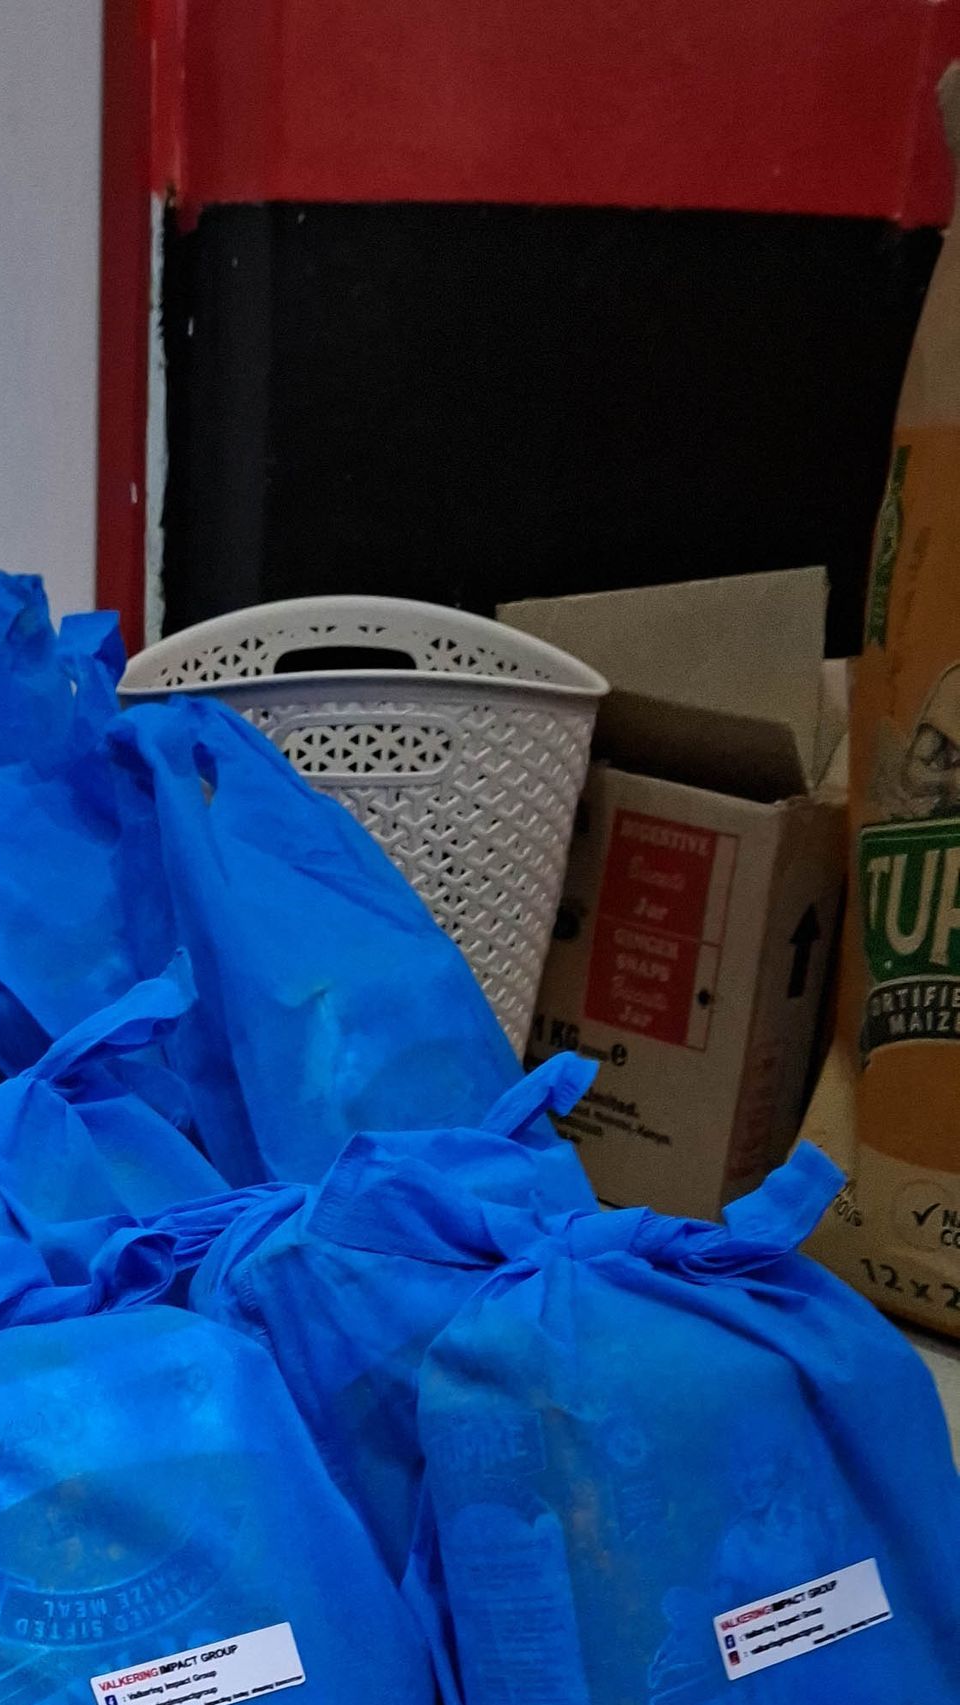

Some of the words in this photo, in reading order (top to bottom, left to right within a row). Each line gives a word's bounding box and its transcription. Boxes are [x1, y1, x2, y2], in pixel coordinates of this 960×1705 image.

[720, 1605, 772, 1631] VALKERING
[807, 1579, 838, 1599] GROUP
[98, 1668, 159, 1692] VALKERING
[159, 1655, 198, 1675] IMPACT
[200, 1644, 238, 1663] GROUP
[165, 1677, 192, 1691] Impact
[192, 1670, 217, 1683] Group
